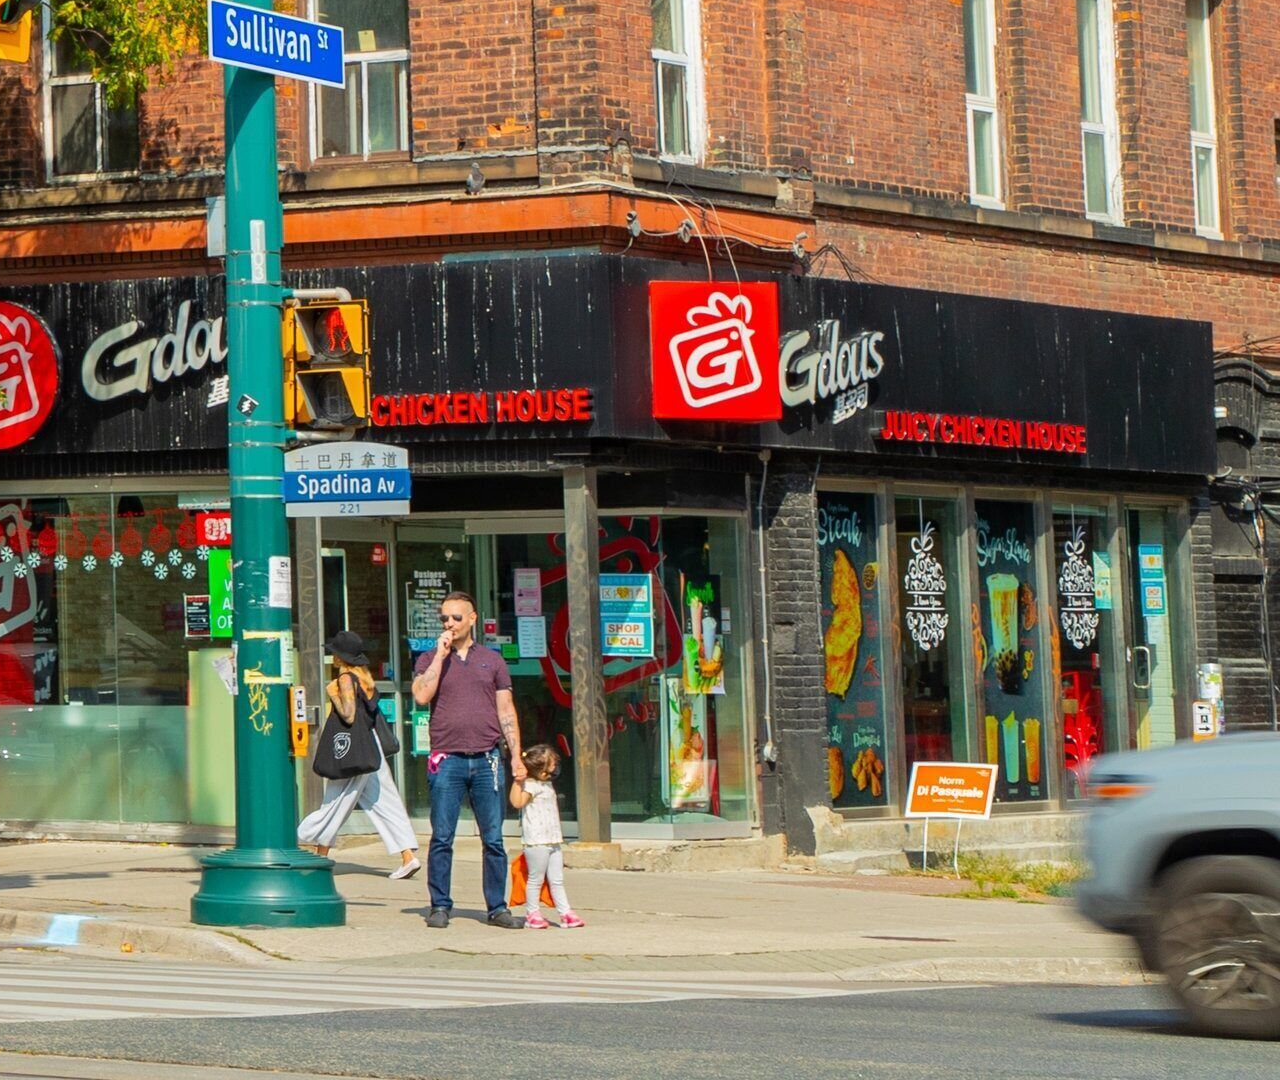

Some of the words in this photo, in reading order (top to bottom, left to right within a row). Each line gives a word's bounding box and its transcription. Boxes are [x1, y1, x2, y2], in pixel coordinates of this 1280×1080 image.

[226, 8, 312, 63] Sullivan
[317, 29, 329, 51] St
[372, 391, 489, 427] CHICKEN
[496, 387, 591, 423] HOUSE
[881, 409, 940, 444] JUICY
[940, 413, 1024, 450] CHICKEN
[1025, 421, 1088, 454] HOUSE
[295, 450, 398, 470] 士巴丹拿道
[297, 473, 372, 500] Spadina
[377, 477, 395, 495] Av
[339, 503, 362, 514] 221
[816, 507, 863, 548] Steak
[608, 623, 641, 633] SHOP
[606, 636, 643, 647] LCAL
[938, 776, 965, 785] Norm
[917, 785, 929, 796] Di
[930, 785, 984, 799] Pasquale
